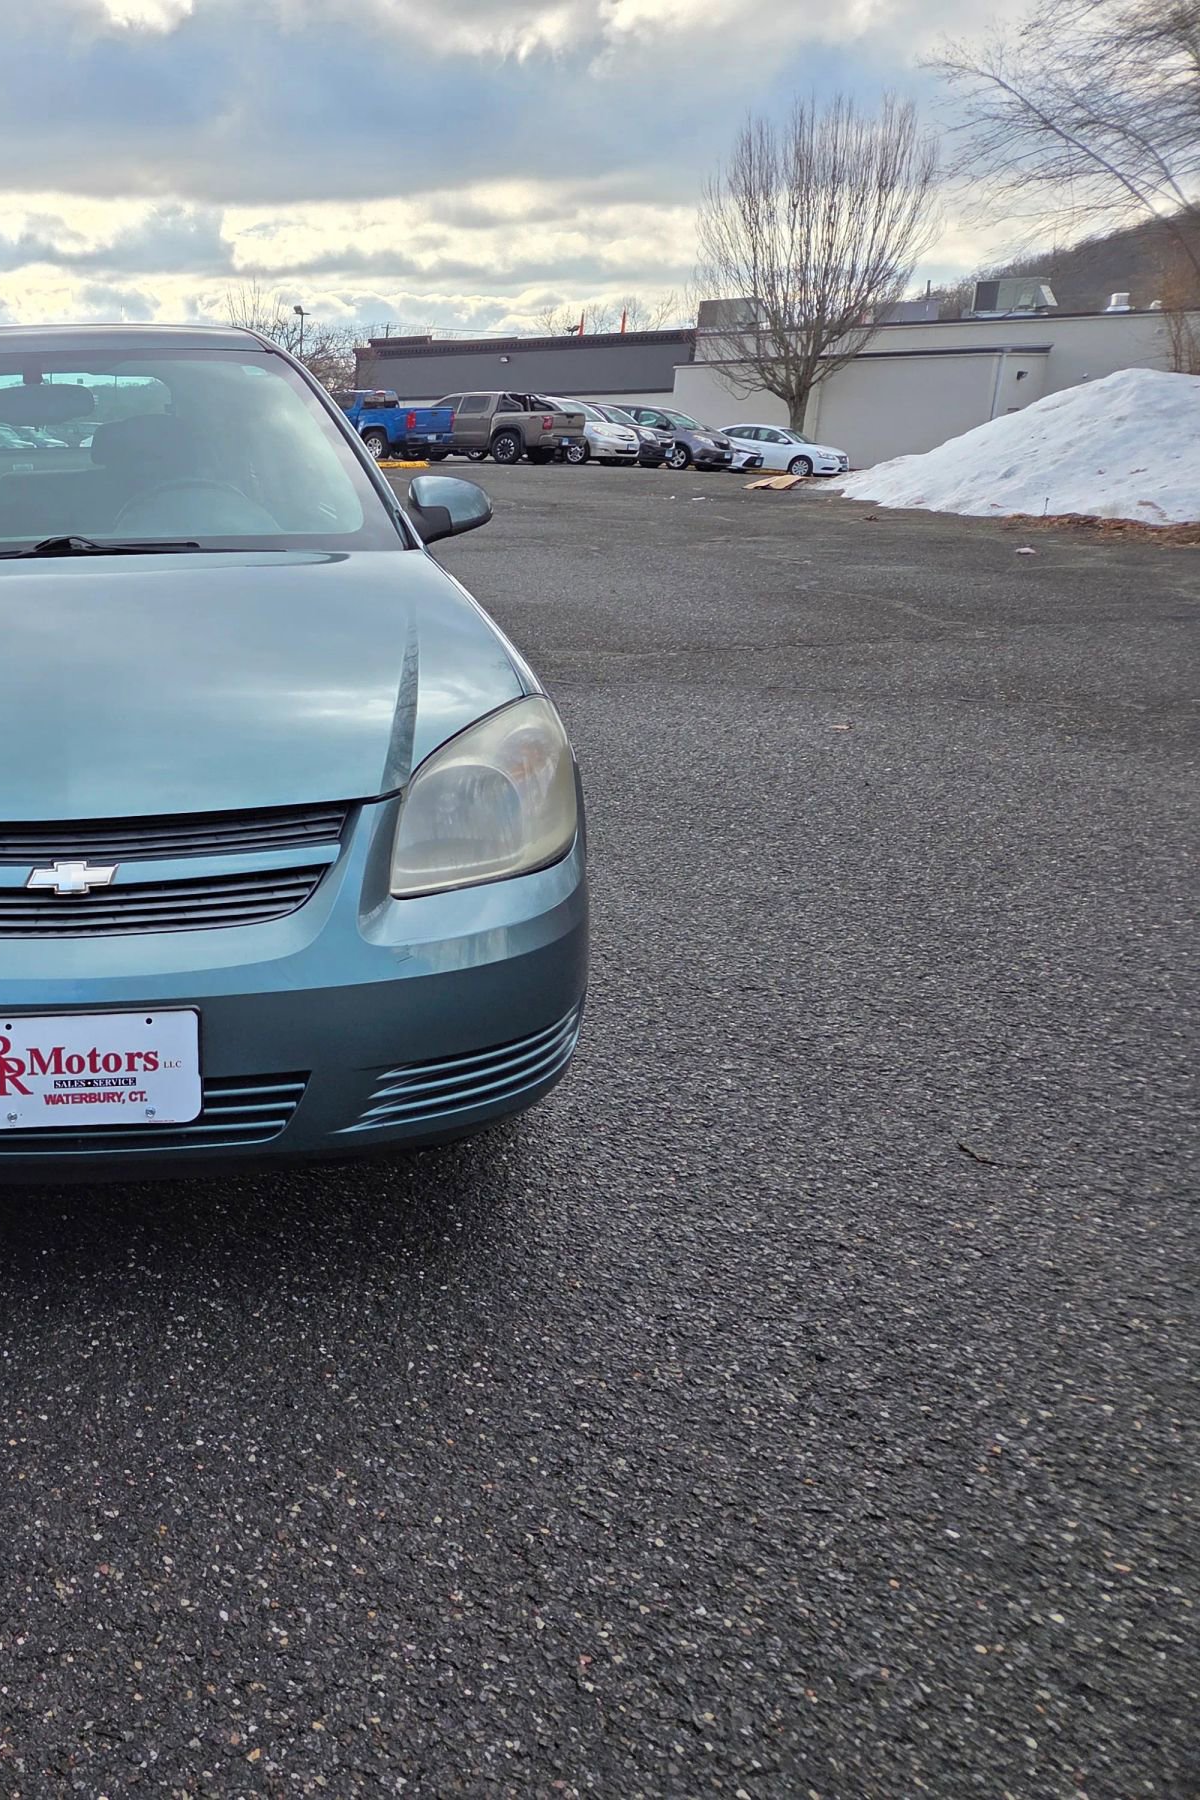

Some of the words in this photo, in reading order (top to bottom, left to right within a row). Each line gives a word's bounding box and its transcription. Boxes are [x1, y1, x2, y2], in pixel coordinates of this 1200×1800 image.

[26, 1046, 160, 1076] Motors
[163, 1060, 182, 1069] LLC
[55, 1080, 86, 1089] SALES
[92, 1077, 136, 1087] SERVICE
[43, 1091, 126, 1105] WATERBURY,
[128, 1090, 148, 1102] CT.
